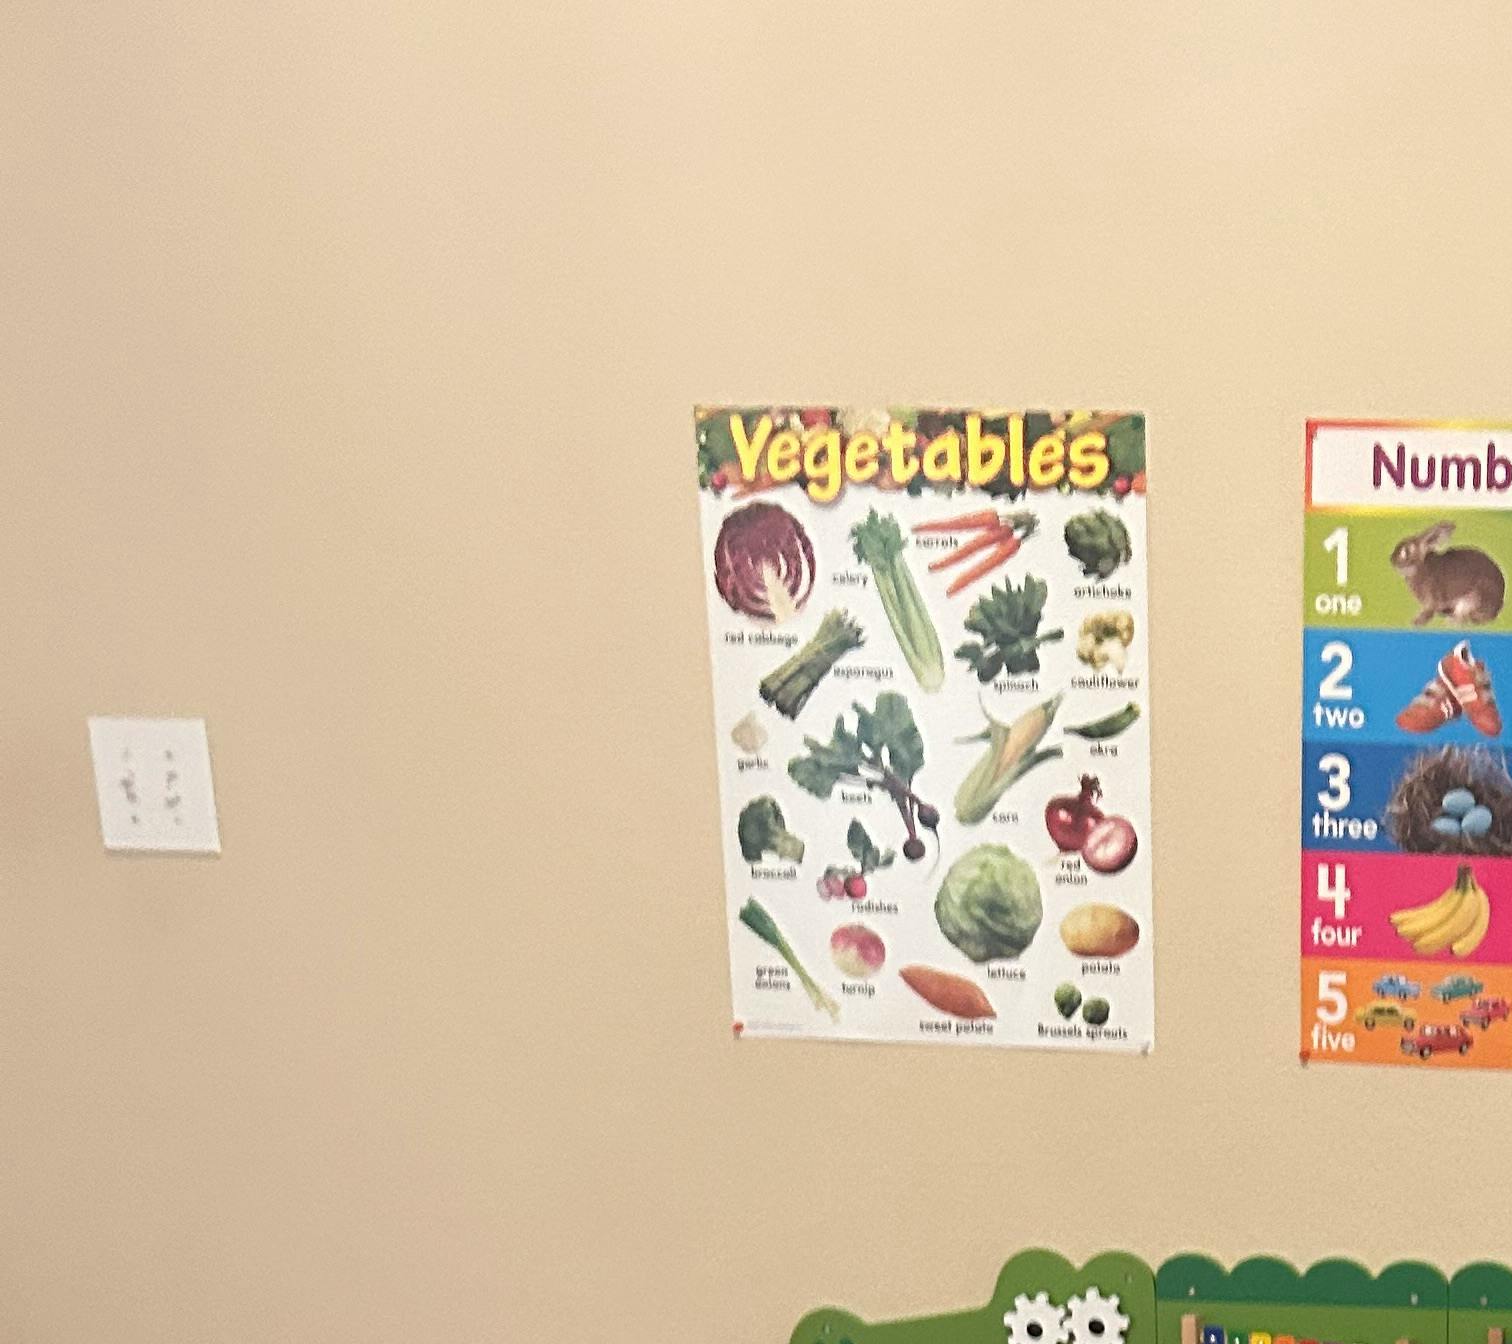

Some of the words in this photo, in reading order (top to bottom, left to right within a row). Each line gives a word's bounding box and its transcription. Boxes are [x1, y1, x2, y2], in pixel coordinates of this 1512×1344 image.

[729, 414, 1110, 501] Vegetables
[1322, 527, 1349, 586] 1
[1315, 595, 1362, 617] one
[1318, 641, 1353, 700] 2
[1313, 703, 1365, 729] two
[1318, 752, 1351, 810] 3
[1312, 812, 1378, 840] three
[1316, 863, 1351, 919] 4
[1311, 918, 1362, 948] four
[1318, 973, 1347, 1025] 5
[1311, 1024, 1355, 1053] five
